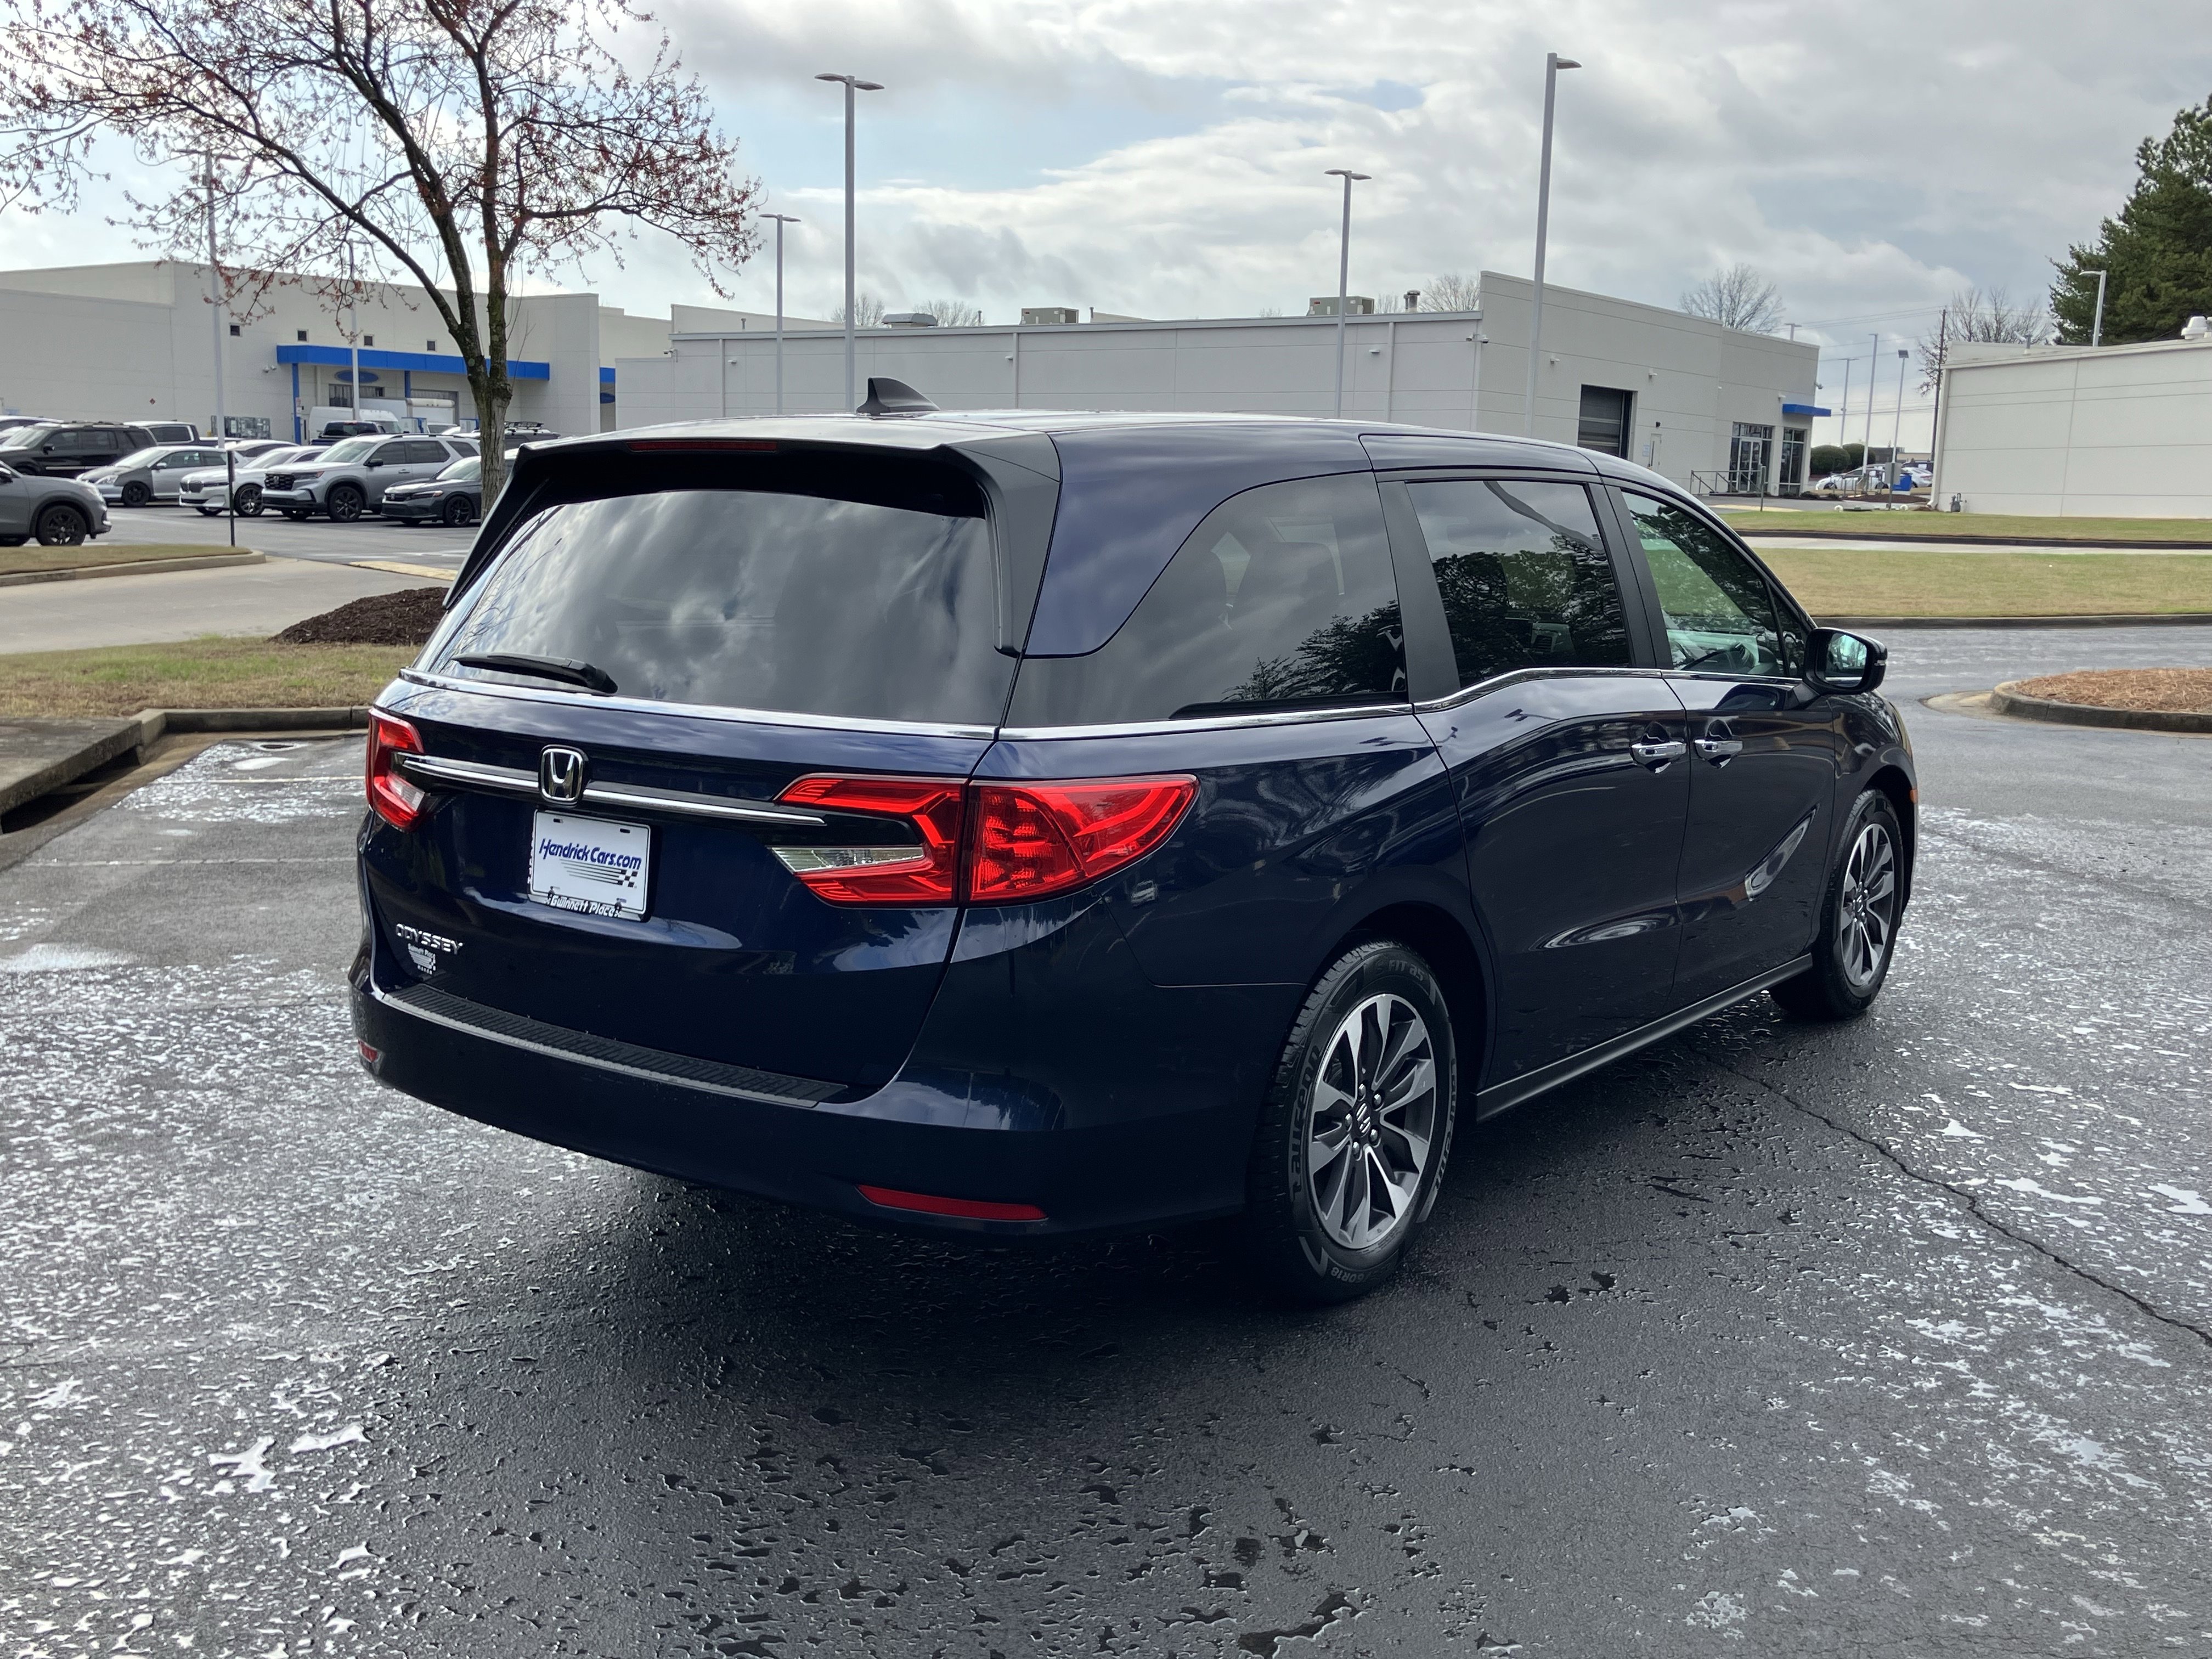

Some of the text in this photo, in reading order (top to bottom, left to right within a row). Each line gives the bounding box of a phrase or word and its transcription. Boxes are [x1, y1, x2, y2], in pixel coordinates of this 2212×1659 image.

[539, 838, 642, 870] HendrickCars.com
[550, 895, 615, 917] Gwinnett Place
[396, 923, 464, 955] ODYSSEY
[1388, 959, 1408, 971] FIT
